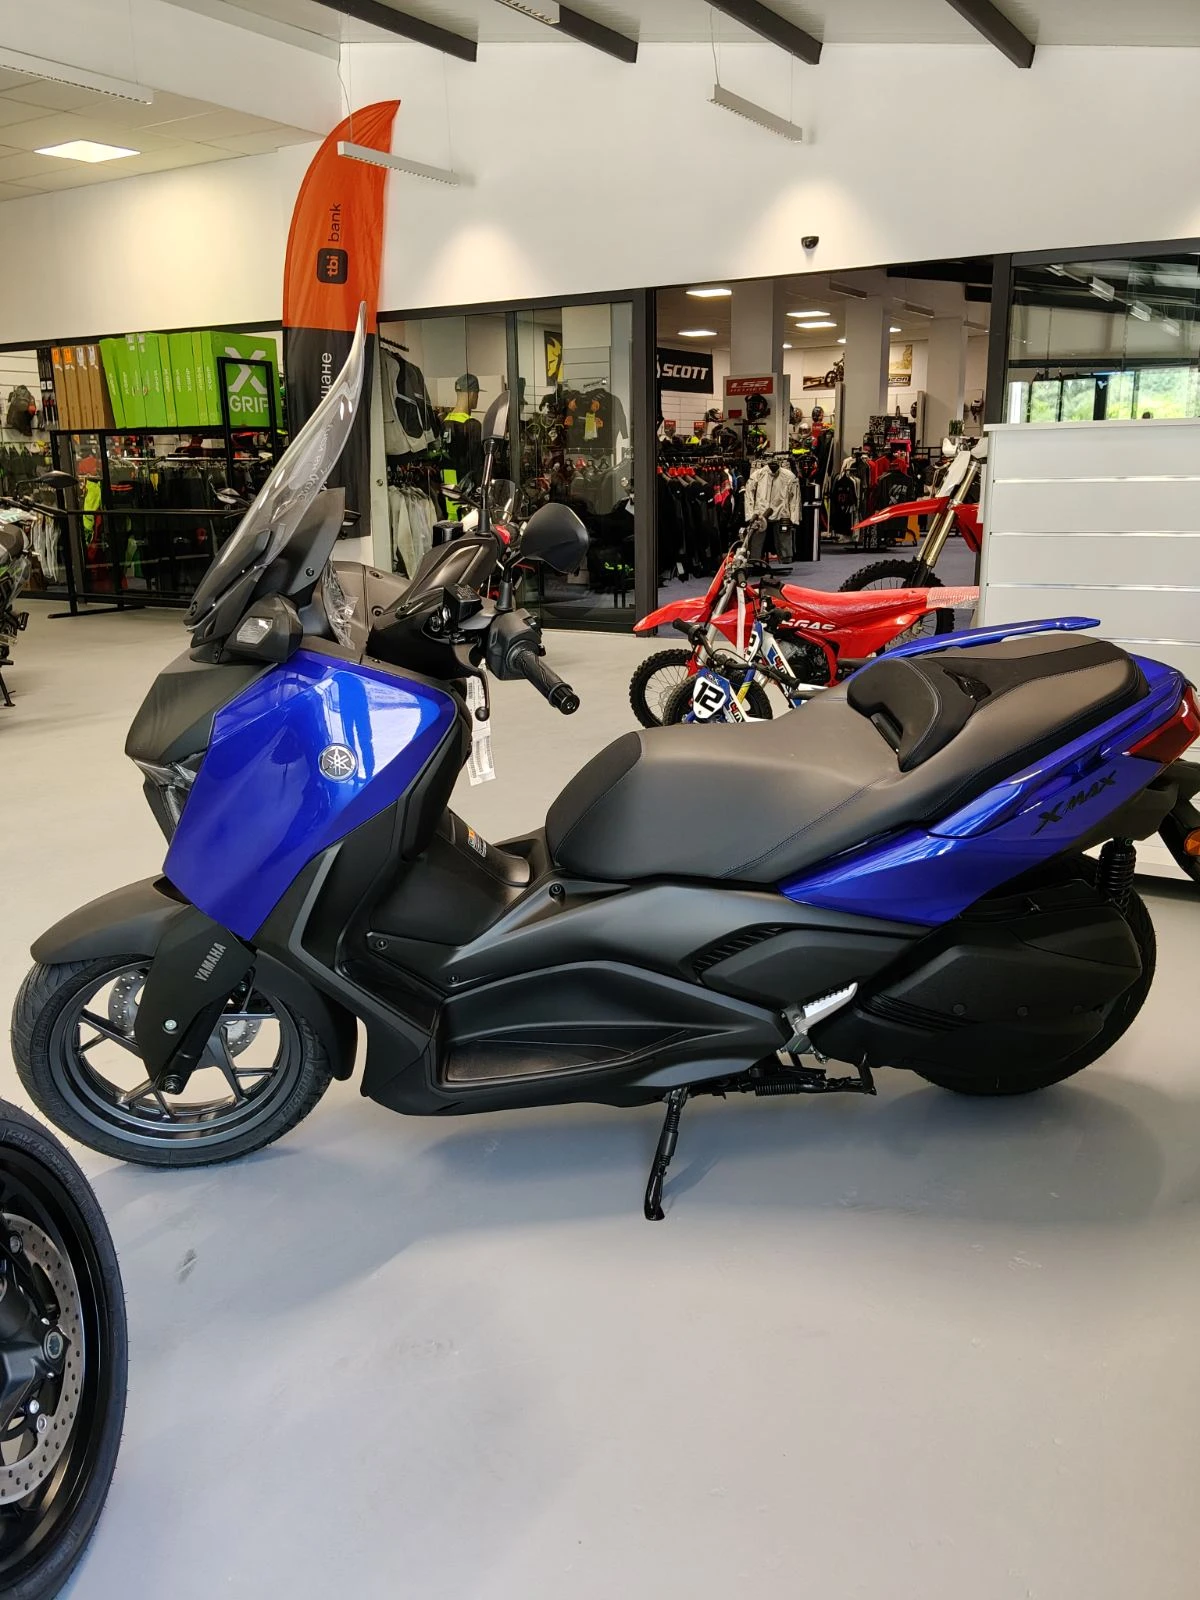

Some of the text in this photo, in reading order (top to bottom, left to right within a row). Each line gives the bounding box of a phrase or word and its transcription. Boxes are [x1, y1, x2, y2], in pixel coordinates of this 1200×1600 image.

[326, 203, 341, 277] tbi bank
[662, 363, 709, 380] SCOTT
[731, 380, 769, 389] LS2
[694, 681, 725, 713] 12
[194, 942, 227, 982] YAMAHA
